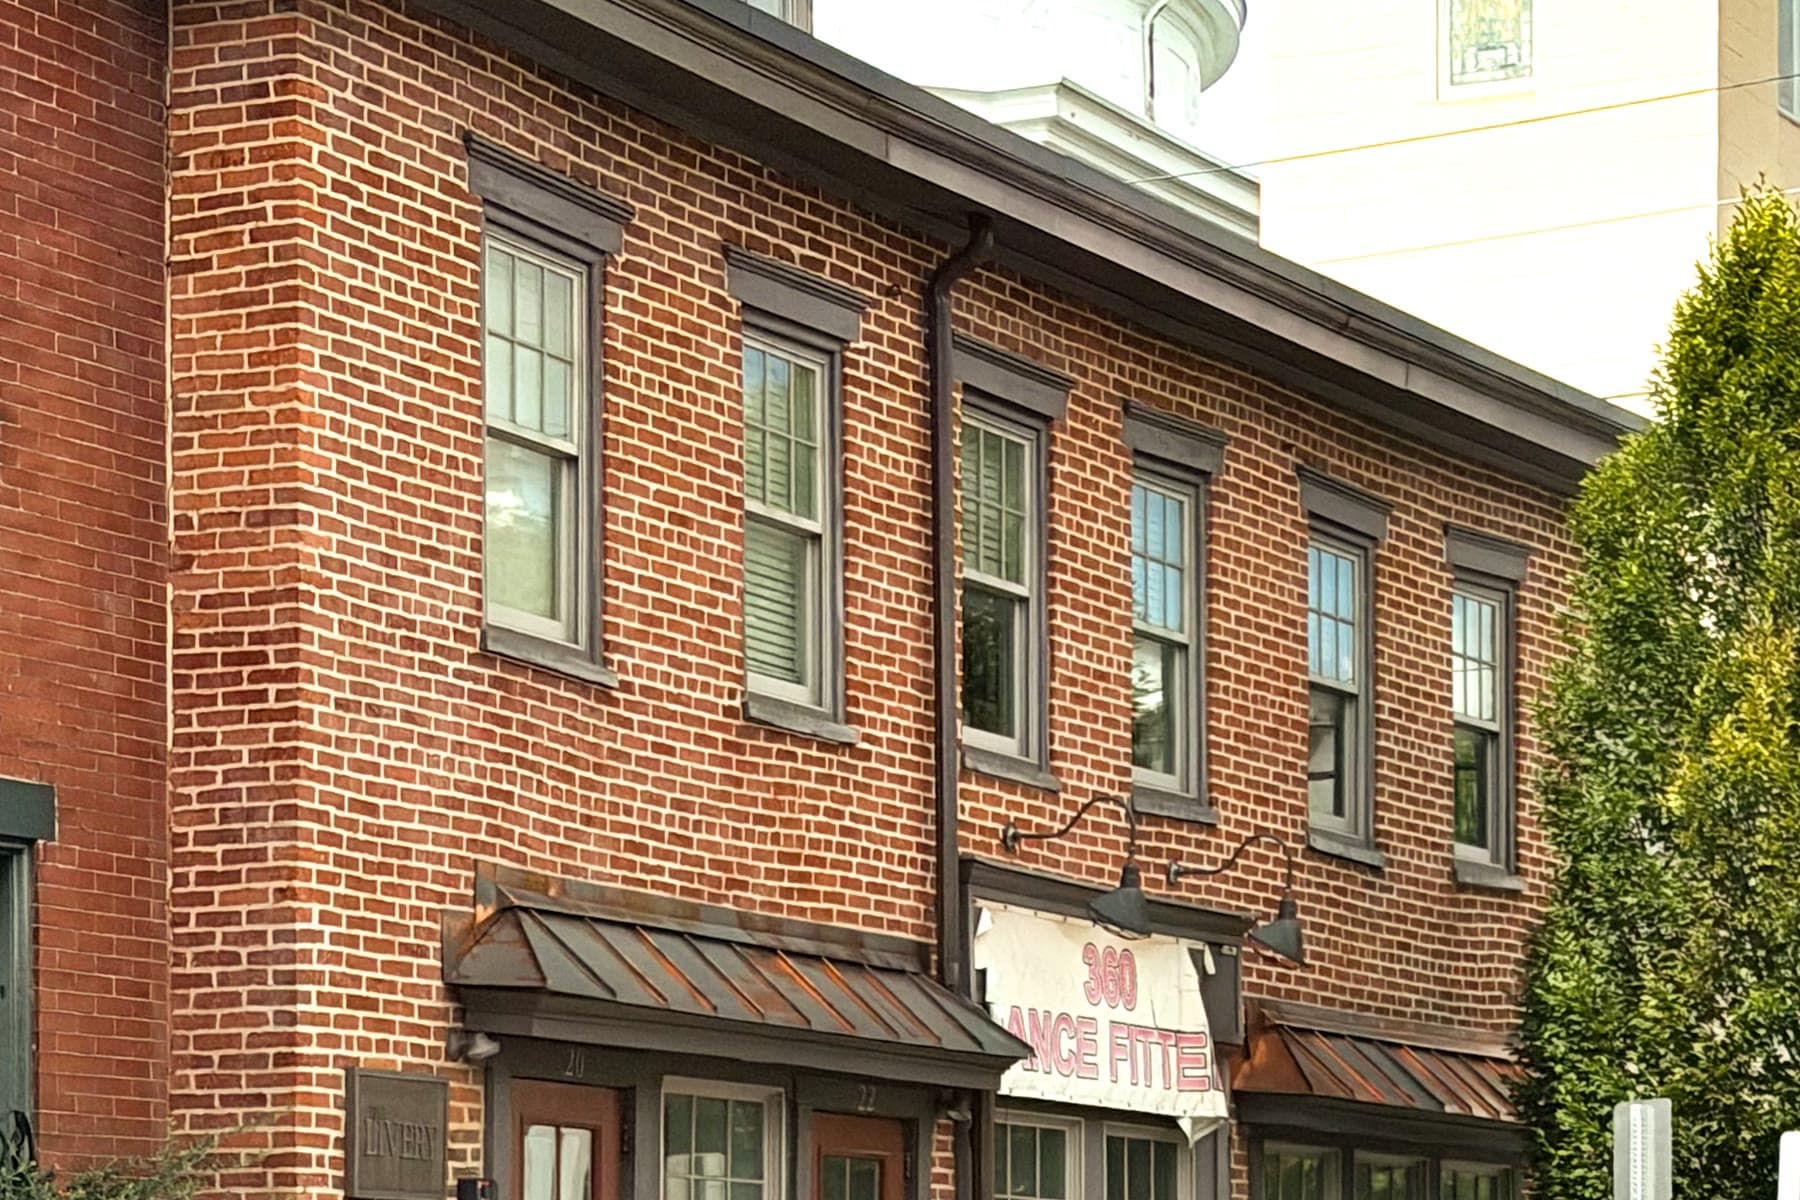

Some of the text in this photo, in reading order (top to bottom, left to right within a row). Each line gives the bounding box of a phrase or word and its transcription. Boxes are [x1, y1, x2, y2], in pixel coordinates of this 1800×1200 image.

[1082, 942, 1137, 1011] 360
[1007, 1005, 1224, 1092] ANCE FITTE
[363, 1119, 437, 1161] LIVERY
